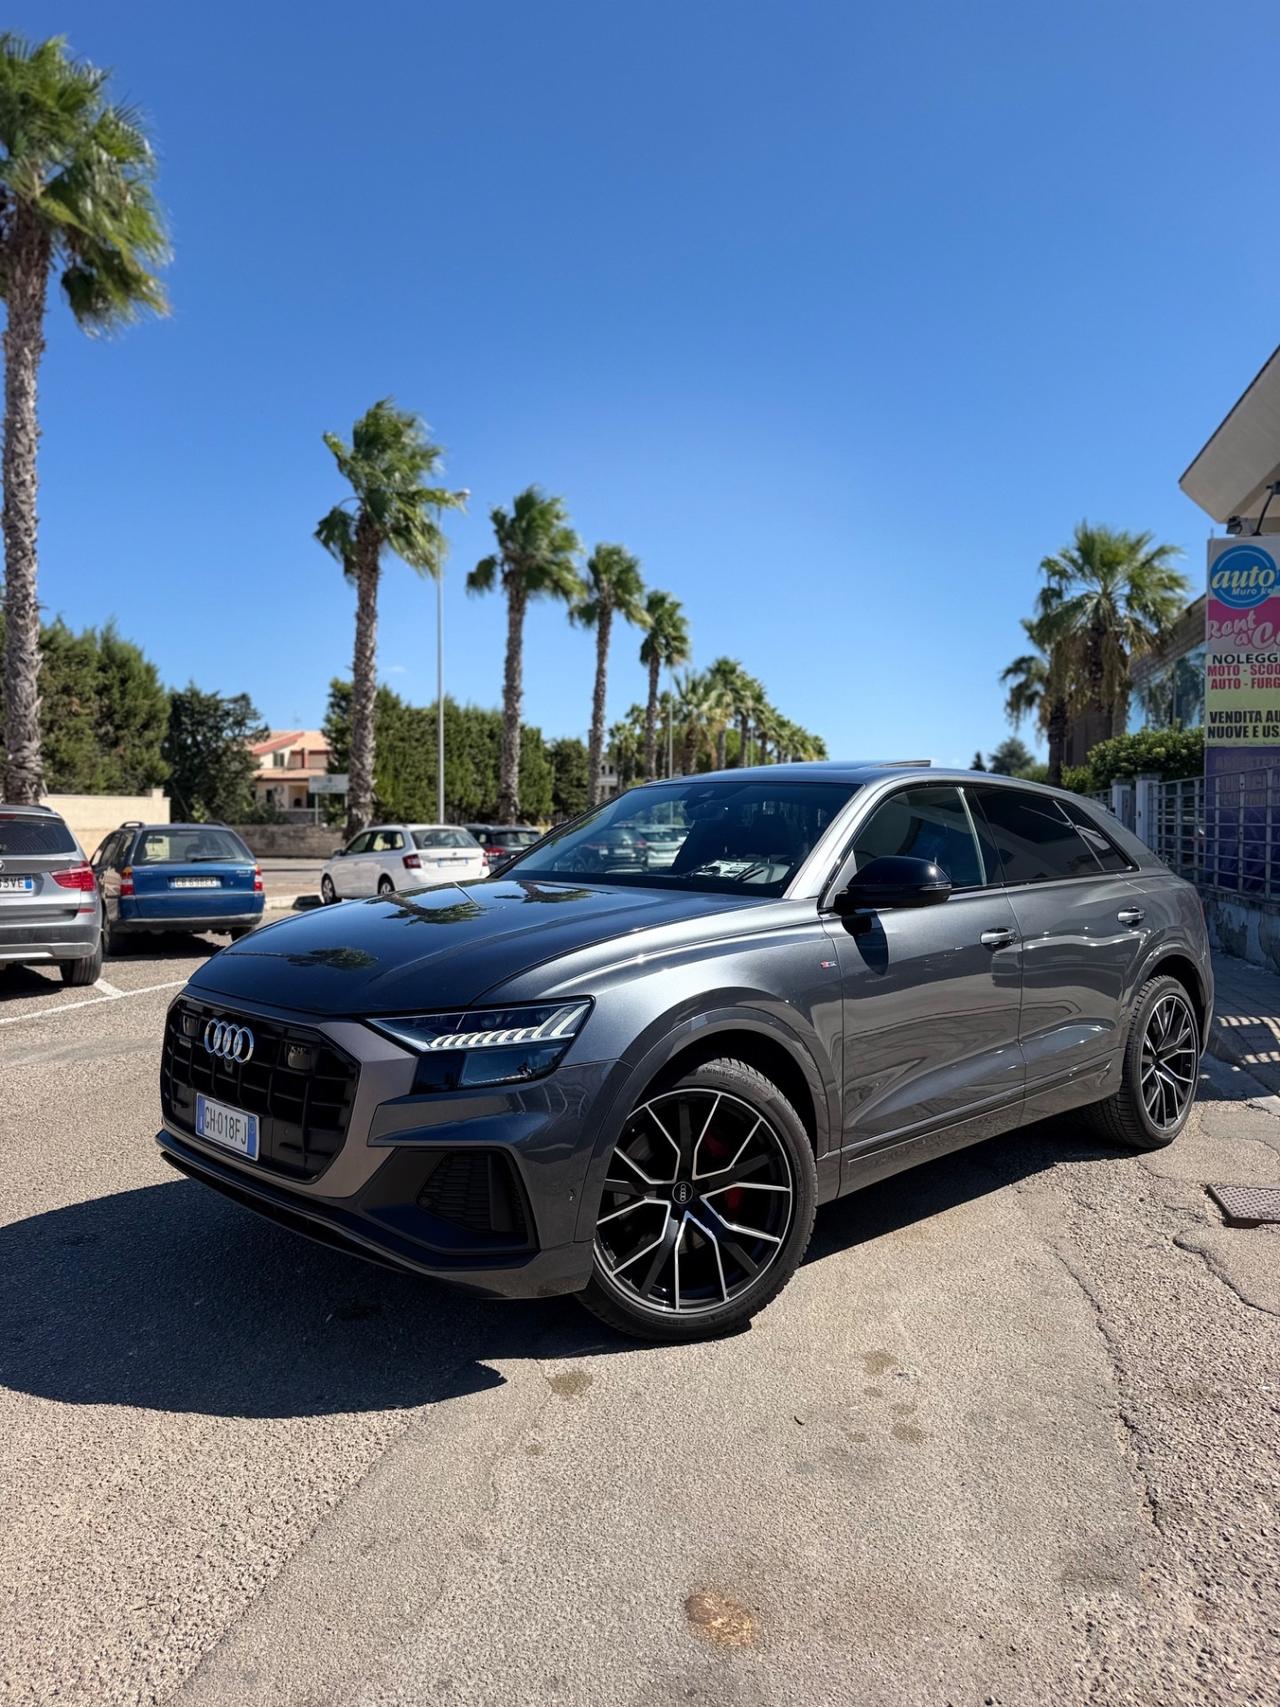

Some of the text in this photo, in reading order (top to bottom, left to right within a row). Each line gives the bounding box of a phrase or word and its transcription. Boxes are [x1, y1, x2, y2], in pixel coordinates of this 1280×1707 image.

[1211, 566, 1276, 589] auto
[1232, 587, 1257, 595] Muro
[1208, 610, 1257, 639] Rent
[1212, 653, 1278, 664] NOLEGG
[1208, 664, 1241, 676] MOTO
[1250, 664, 1280, 676] SCOO
[1211, 678, 1241, 690] AUTO
[1251, 677, 1280, 689] FURG
[1209, 710, 1263, 724] VENDITA
[1207, 724, 1280, 739] NUOVE E US
